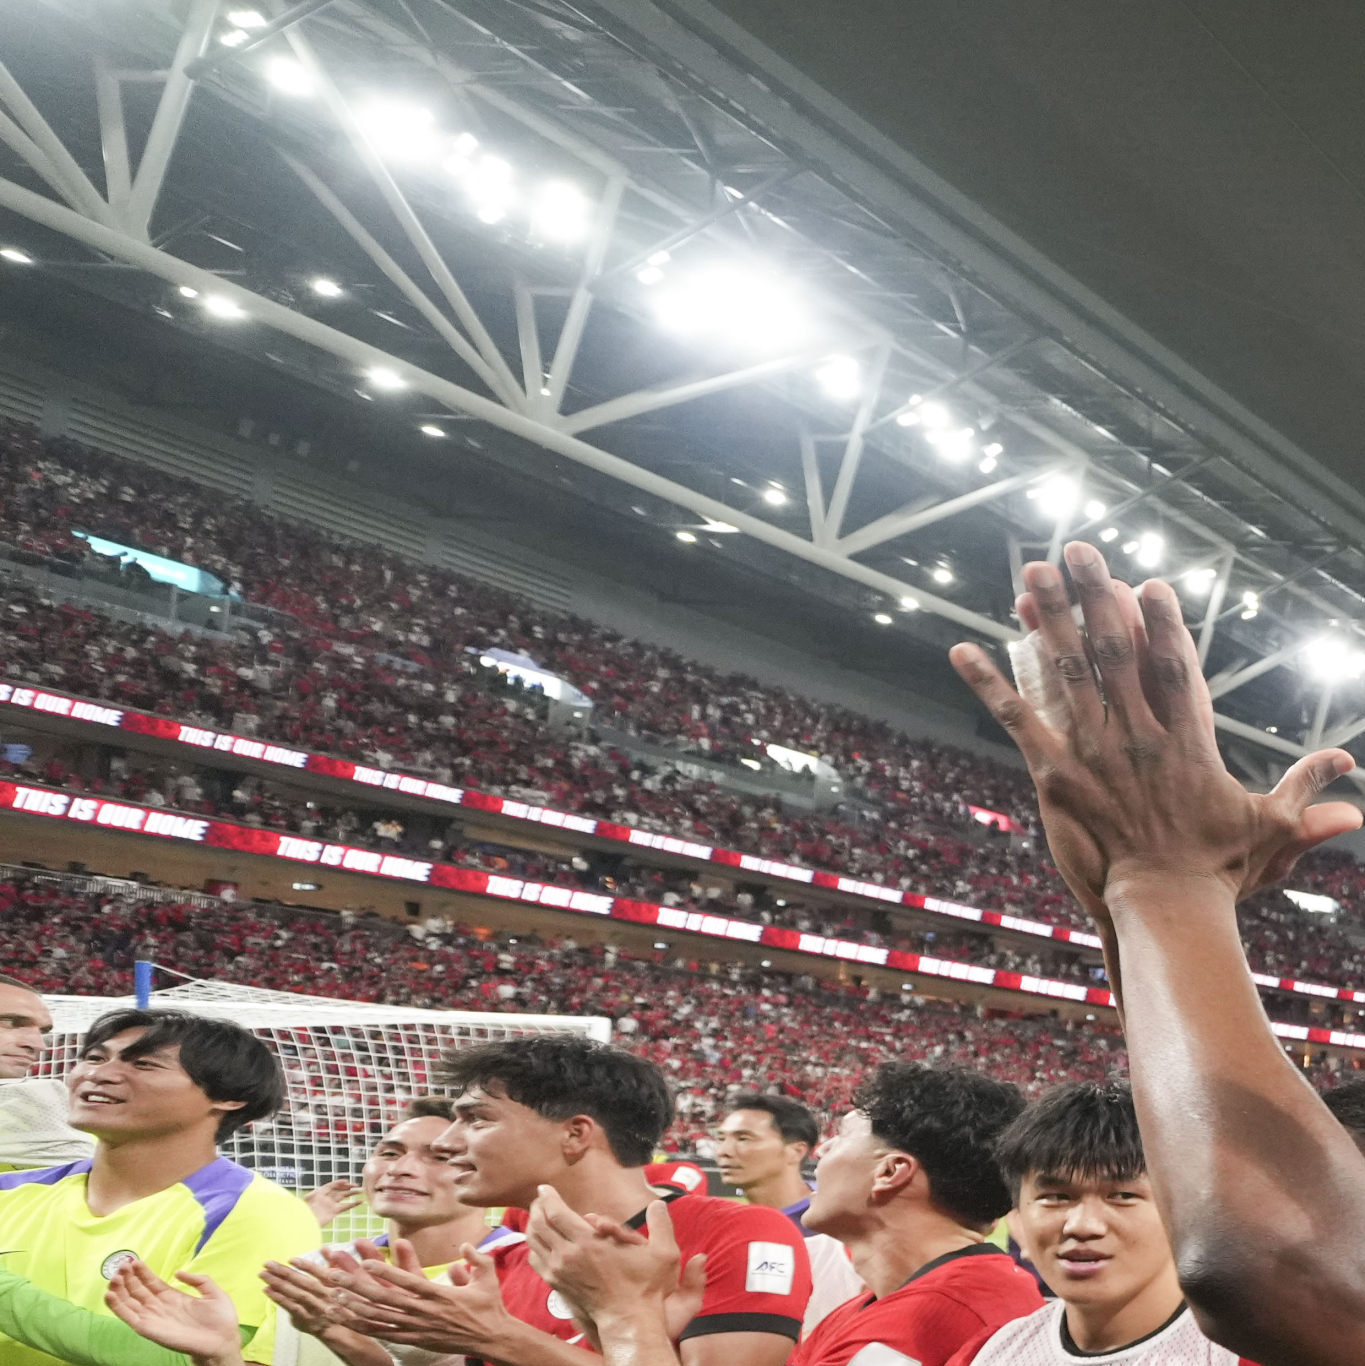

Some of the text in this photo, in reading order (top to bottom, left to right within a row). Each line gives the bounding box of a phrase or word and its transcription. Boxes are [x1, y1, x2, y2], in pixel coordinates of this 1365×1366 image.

[34, 693, 72, 715] OUR
[71, 702, 123, 726] HOME
[13, 787, 209, 840] THIS IS OUR HOME
[755, 1261, 786, 1273] AFC
